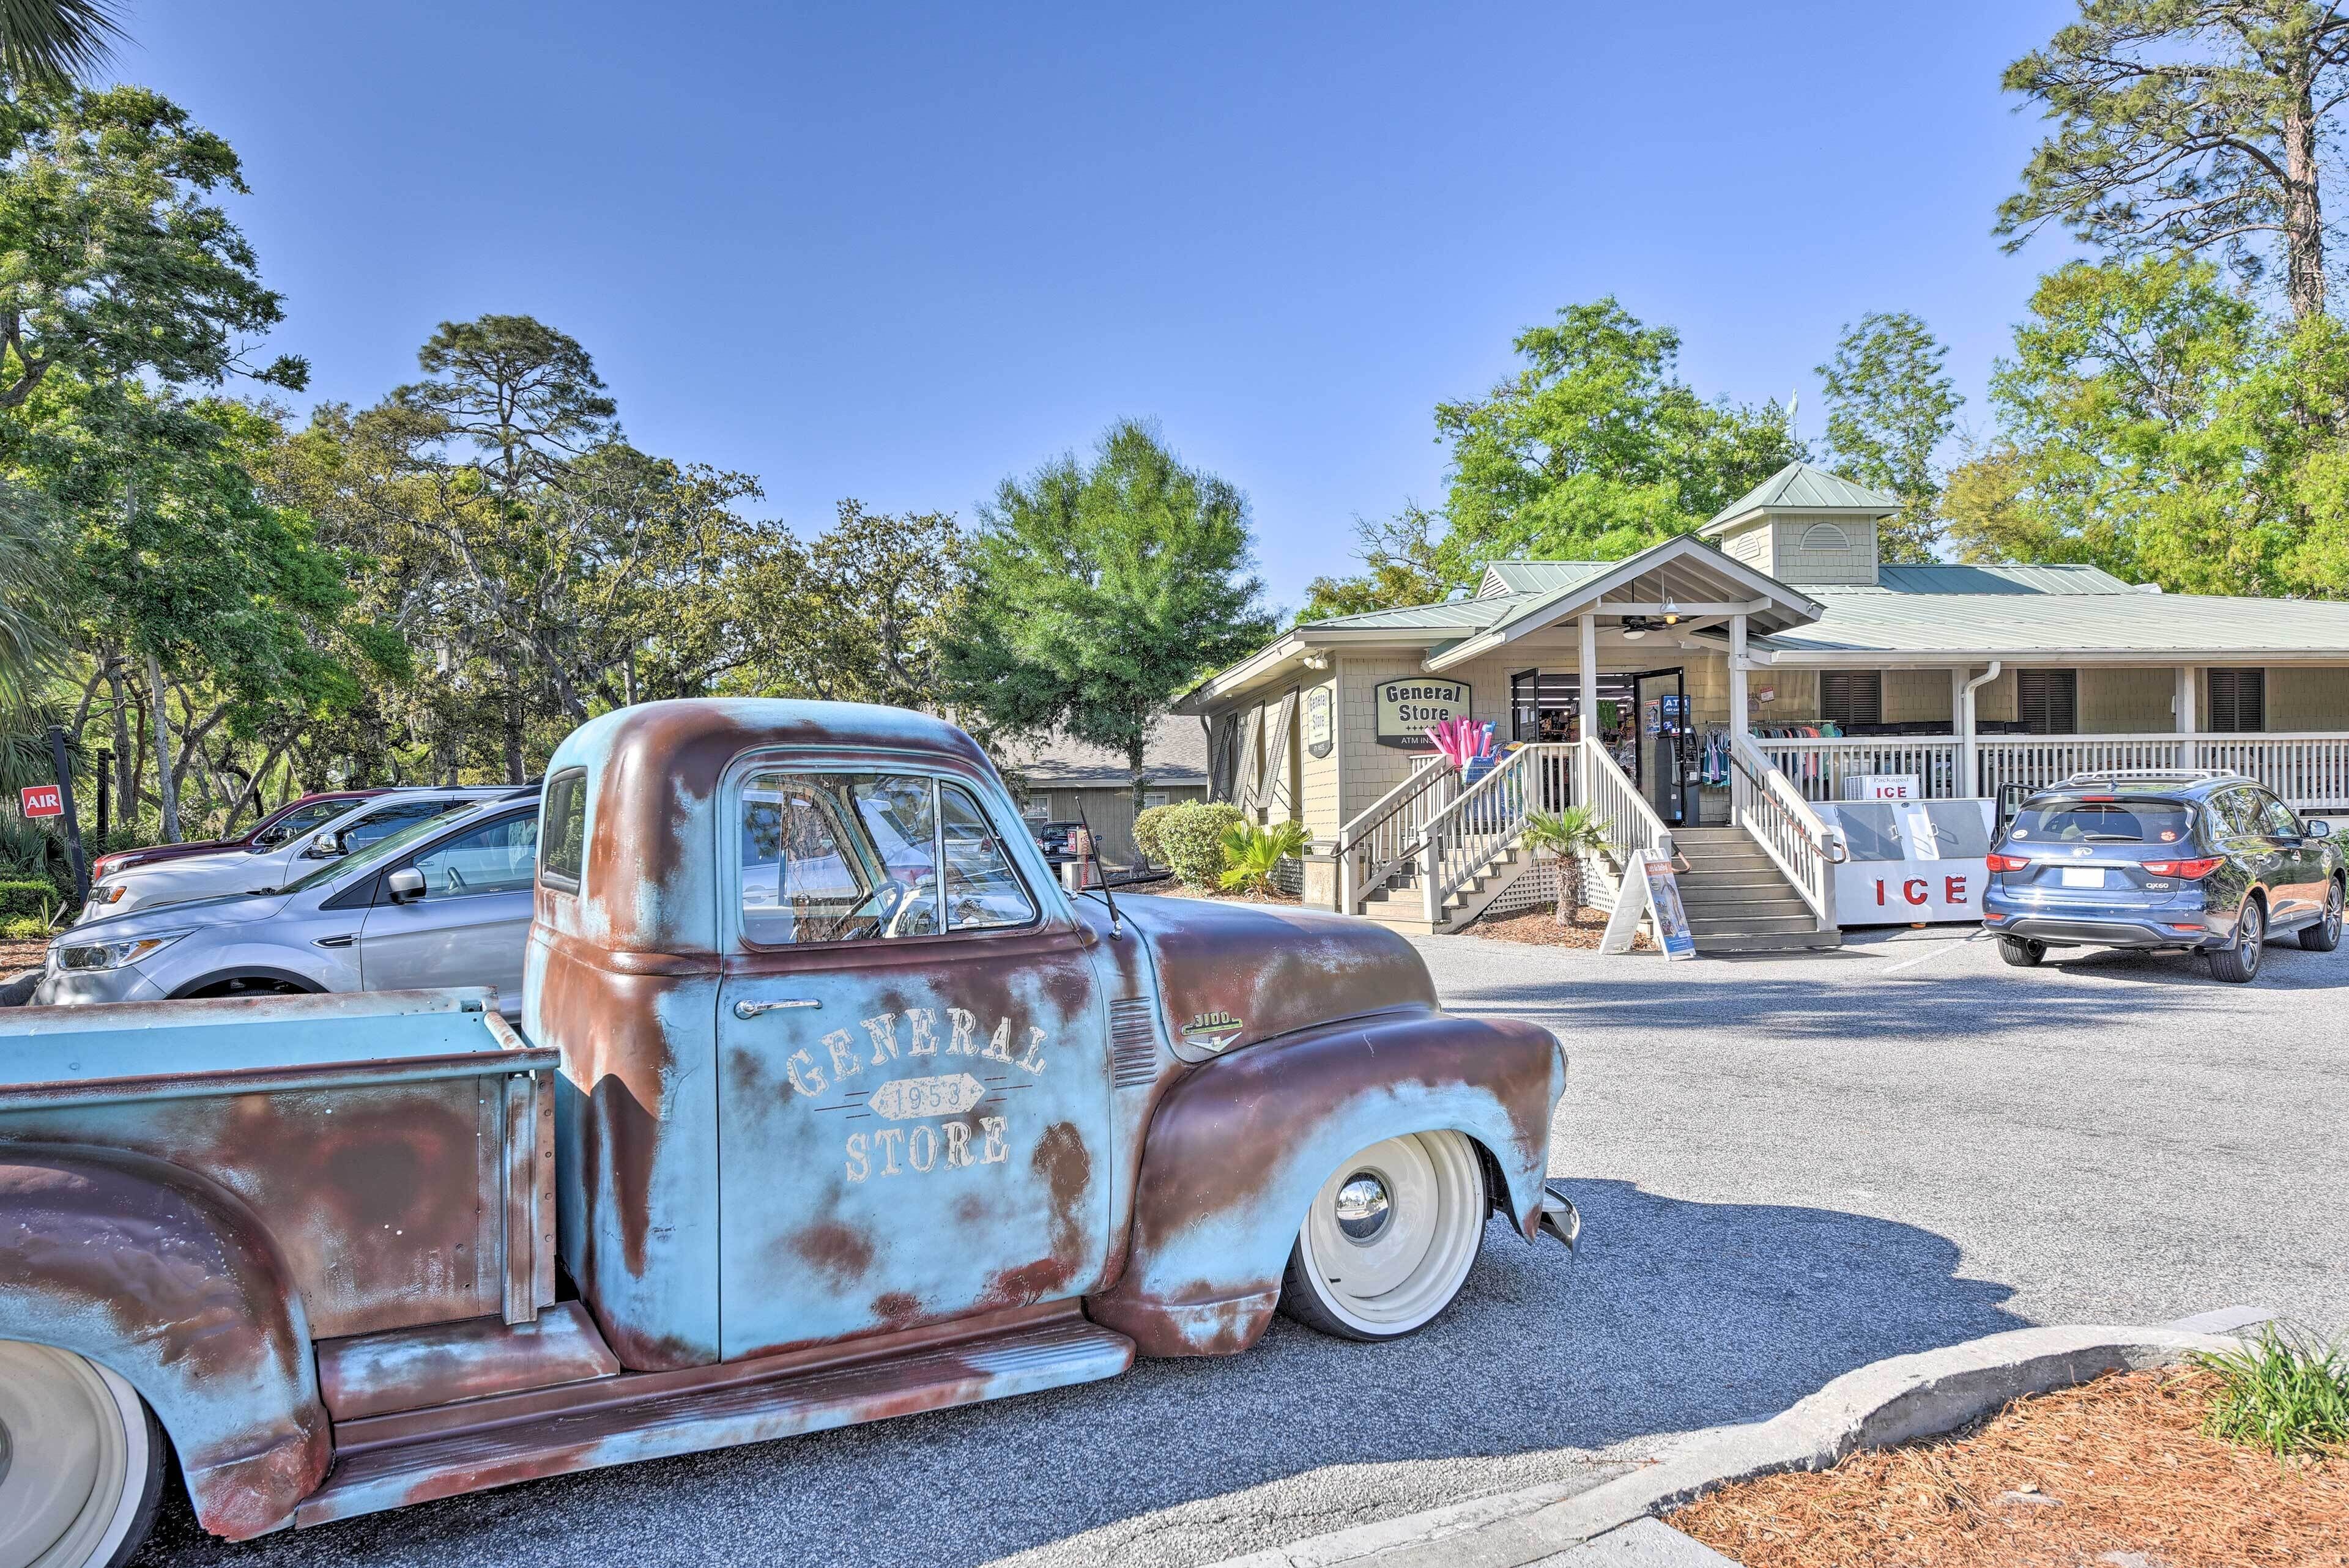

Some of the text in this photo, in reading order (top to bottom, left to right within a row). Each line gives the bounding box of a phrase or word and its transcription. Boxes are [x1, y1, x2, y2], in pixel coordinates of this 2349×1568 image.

[1310, 691, 1327, 712] General
[1386, 685, 1461, 703] General
[1313, 714, 1324, 730] Store
[1399, 704, 1449, 722] Store
[1876, 786, 1907, 798] ICE
[26, 794, 59, 809] AIR
[1876, 872, 1967, 906] ICE
[1194, 1011, 1230, 1027] 3100
[786, 1007, 1048, 1098] GENERAL
[894, 1082, 962, 1117] 1953
[845, 1115, 1011, 1184] STORE
